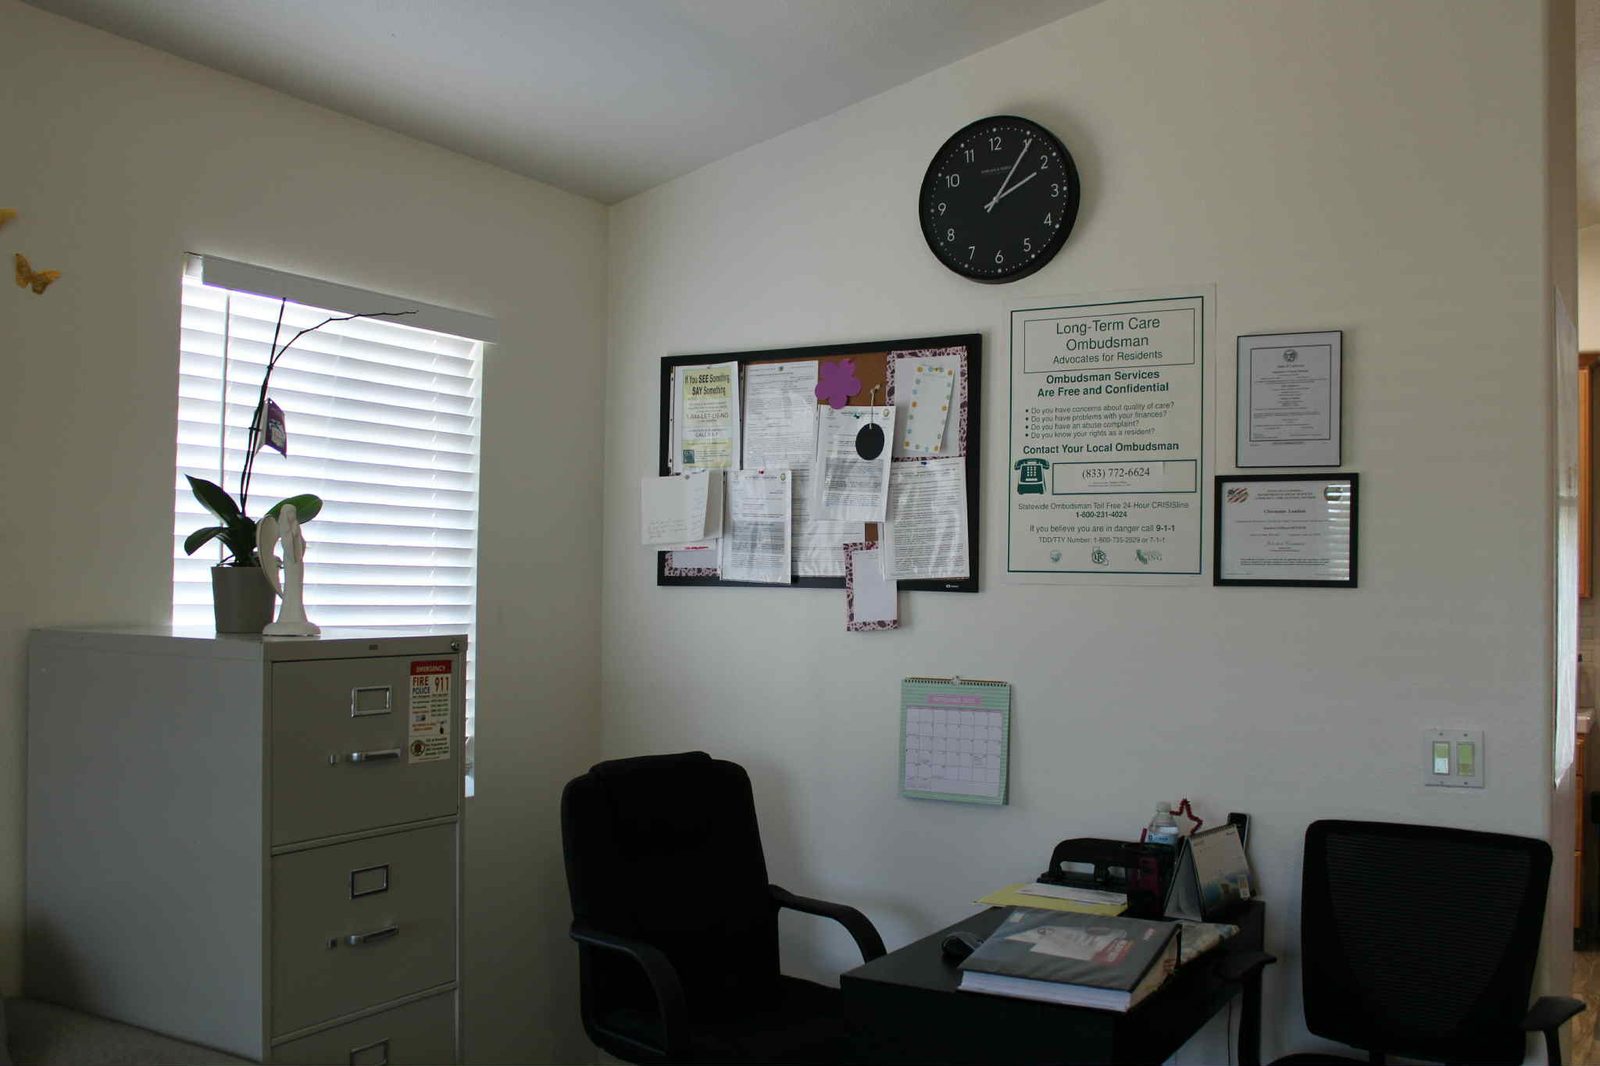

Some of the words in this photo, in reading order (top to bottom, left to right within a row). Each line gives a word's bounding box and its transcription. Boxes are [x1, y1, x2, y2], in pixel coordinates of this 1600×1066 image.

[989, 137, 1002, 151] 12
[964, 149, 975, 164] 11
[1040, 155, 1049, 170] 2
[945, 174, 960, 188] 10
[1051, 183, 1059, 197] 3
[937, 202, 946, 216] 9
[1043, 212, 1052, 226] 4
[947, 228, 955, 242] 8
[1023, 237, 1031, 252] 5
[968, 246, 976, 260] 7
[995, 250, 1004, 264] 6
[1056, 320, 1124, 336] Long-Term
[1128, 317, 1161, 330] Care
[1066, 336, 1149, 351] Ombudsman
[1053, 354, 1099, 365] Advocates
[1102, 353, 1114, 362] for
[1117, 350, 1163, 361] Residents
[689, 375, 698, 384] You
[698, 373, 709, 383] SEE
[709, 373, 730, 384] Something
[1046, 372, 1111, 385] Ombudsman
[1114, 370, 1160, 381] Services
[692, 386, 703, 396] SAY
[703, 385, 726, 397] Something
[1037, 388, 1055, 397] Are
[1058, 386, 1080, 396] Free
[1083, 385, 1102, 395] and
[1105, 382, 1169, 394] Confidential
[1155, 401, 1175, 409] care?
[1072, 413, 1102, 421] problems
[1135, 410, 1167, 418] finances?
[1103, 420, 1140, 428] complaint?
[1073, 431, 1087, 439] your
[1089, 430, 1107, 438] rights
[1023, 446, 1059, 454] Contact
[1062, 444, 1084, 453] Your
[1087, 443, 1113, 453] Local
[1115, 441, 1179, 452] Ombudsman
[1082, 468, 1105, 479] (833)
[1108, 467, 1150, 478] 772-6624
[1050, 502, 1092, 510] Ombudsman
[1114, 525, 1139, 533] danger
[1156, 524, 1175, 532] 9-1-1
[412, 676, 429, 687] FIRE
[434, 677, 449, 693] 911
[412, 686, 430, 695] POLICE
